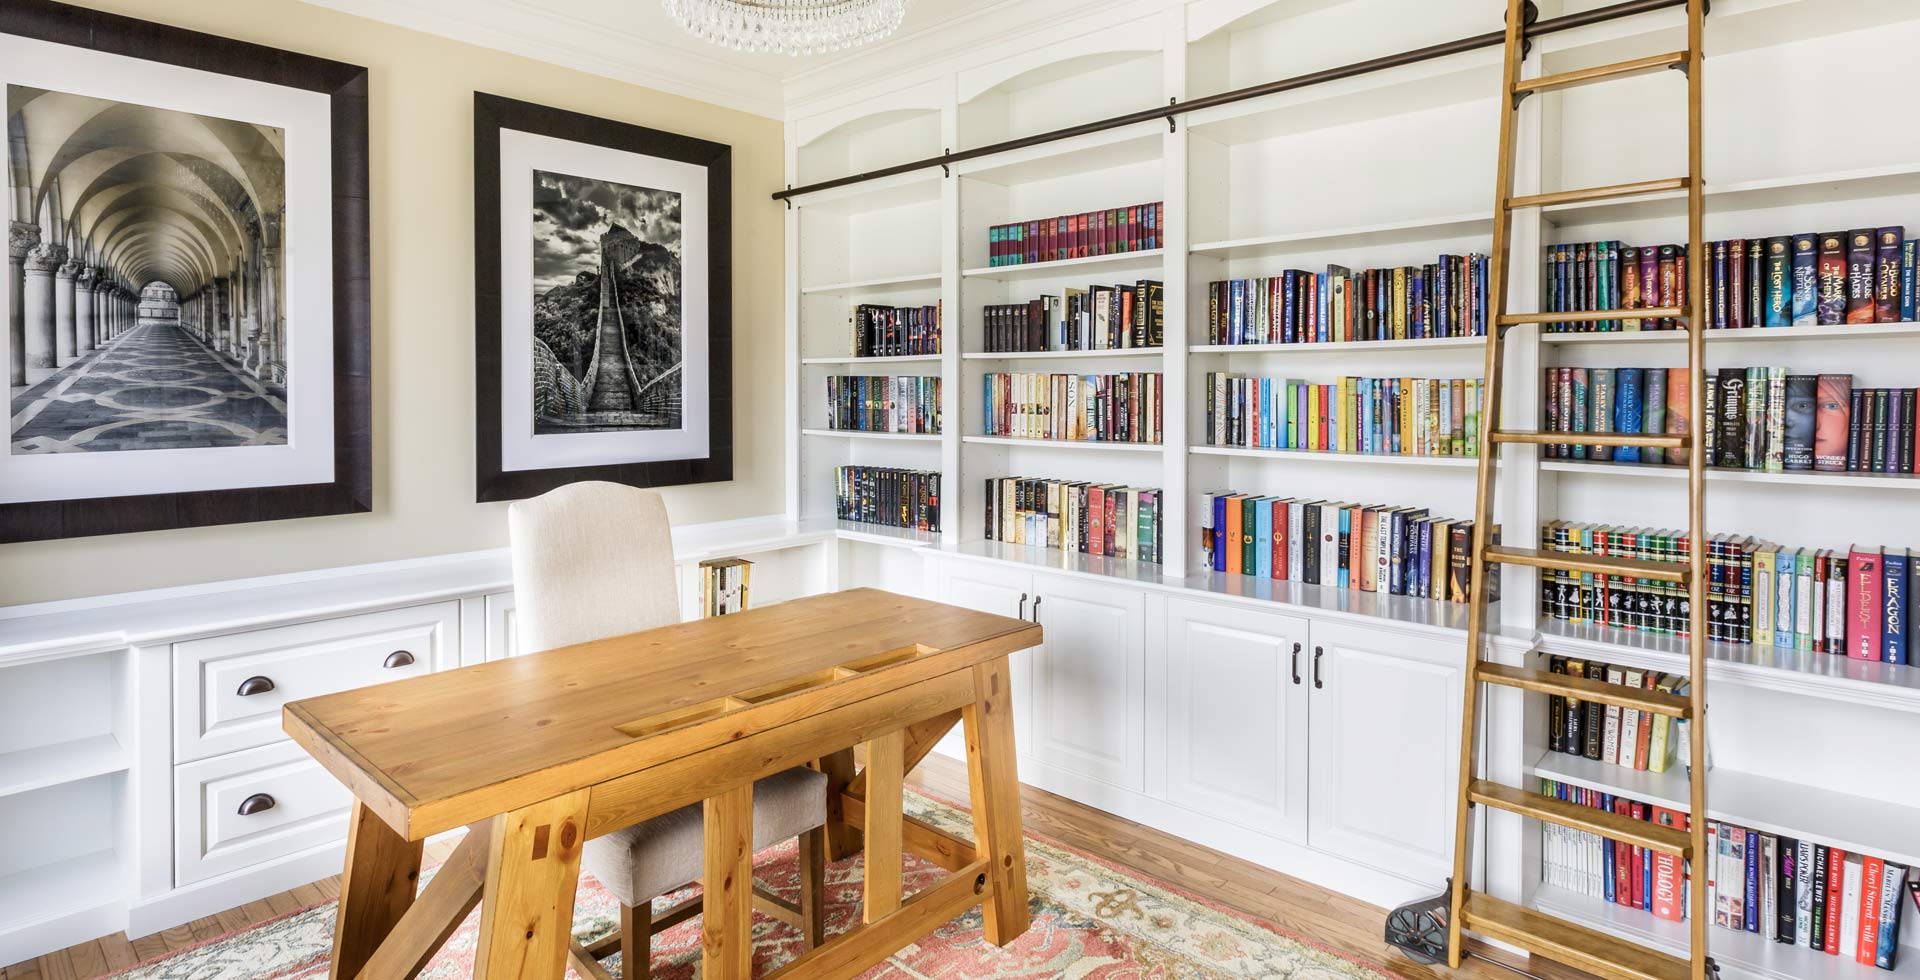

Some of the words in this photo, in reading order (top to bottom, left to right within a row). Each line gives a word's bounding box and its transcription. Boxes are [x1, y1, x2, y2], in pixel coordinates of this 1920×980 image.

[1773, 261, 1782, 271] THE
[1804, 265, 1812, 275] THE
[1824, 262, 1830, 271] OF
[1832, 266, 1840, 276] THE
[1863, 262, 1872, 272] THE
[1771, 270, 1783, 290] LOST
[1795, 267, 1804, 302] NEPTUNE
[1803, 275, 1812, 293] SON
[1821, 271, 1833, 304] ATHENA
[1832, 276, 1844, 302] MARK
[1850, 272, 1861, 299] HADES
[1862, 272, 1874, 299] HOUSE
[1879, 264, 1889, 300] OLYMPUS
[1889, 270, 1899, 297] BLOOD
[1771, 290, 1783, 313] HERO
[1627, 384, 1635, 410] HARRY
[1722, 379, 1743, 420] Grimm's
[1859, 574, 1871, 630] ELDEST
[1886, 578, 1901, 635] ERAGON
[1606, 730, 1616, 756] WOMEN
[1800, 843, 1809, 862] LIAR'S
[1816, 848, 1824, 878] MICHAEL
[1800, 863, 1809, 884] POKER
[1865, 863, 1879, 889] Cheryl
[1884, 869, 1894, 897] MARILYN
[1815, 880, 1823, 902] LEWIS
[1863, 891, 1876, 919] Strayed
[1882, 899, 1891, 926] MANSON
[1863, 924, 1874, 942] wild
